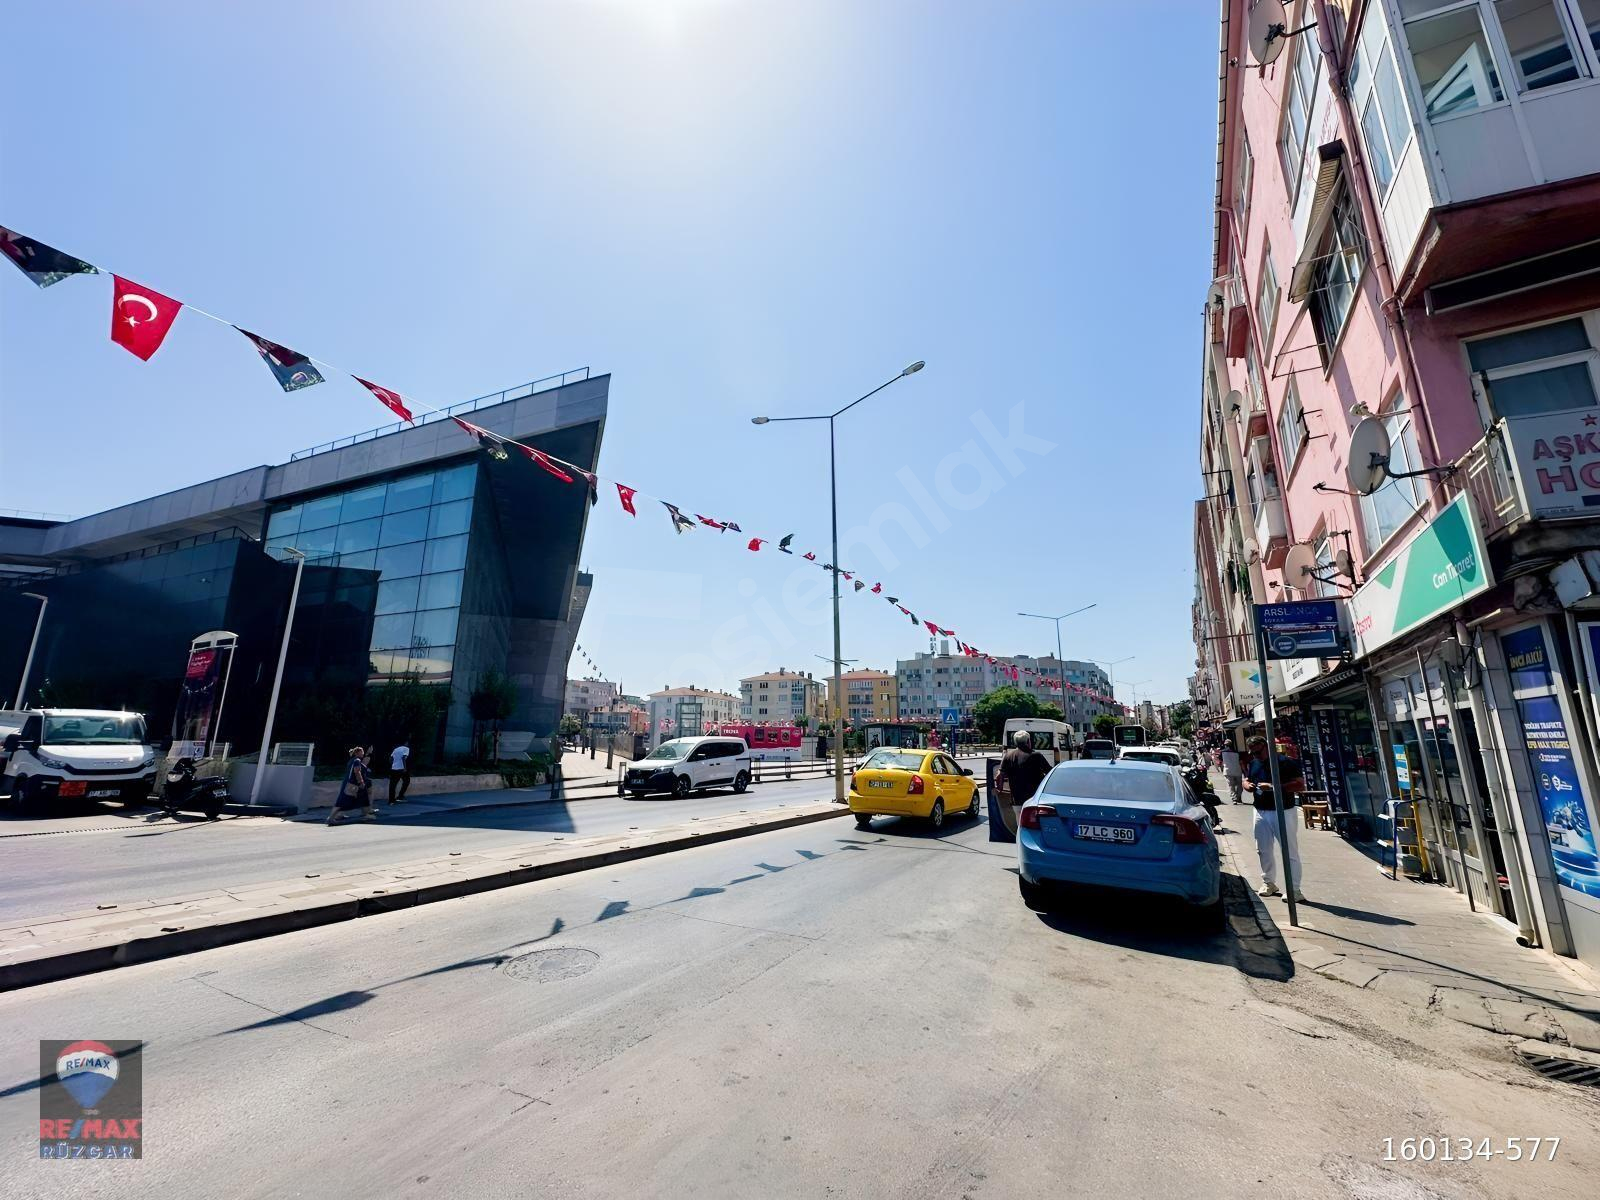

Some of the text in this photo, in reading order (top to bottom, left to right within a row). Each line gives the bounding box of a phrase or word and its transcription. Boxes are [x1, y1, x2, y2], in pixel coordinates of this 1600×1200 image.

[1433, 552, 1474, 589] Can Ticaret
[1525, 646, 1543, 665] AKÜ
[1069, 808, 1136, 819] VOLVO
[1079, 824, 1133, 839] 17 LC 960
